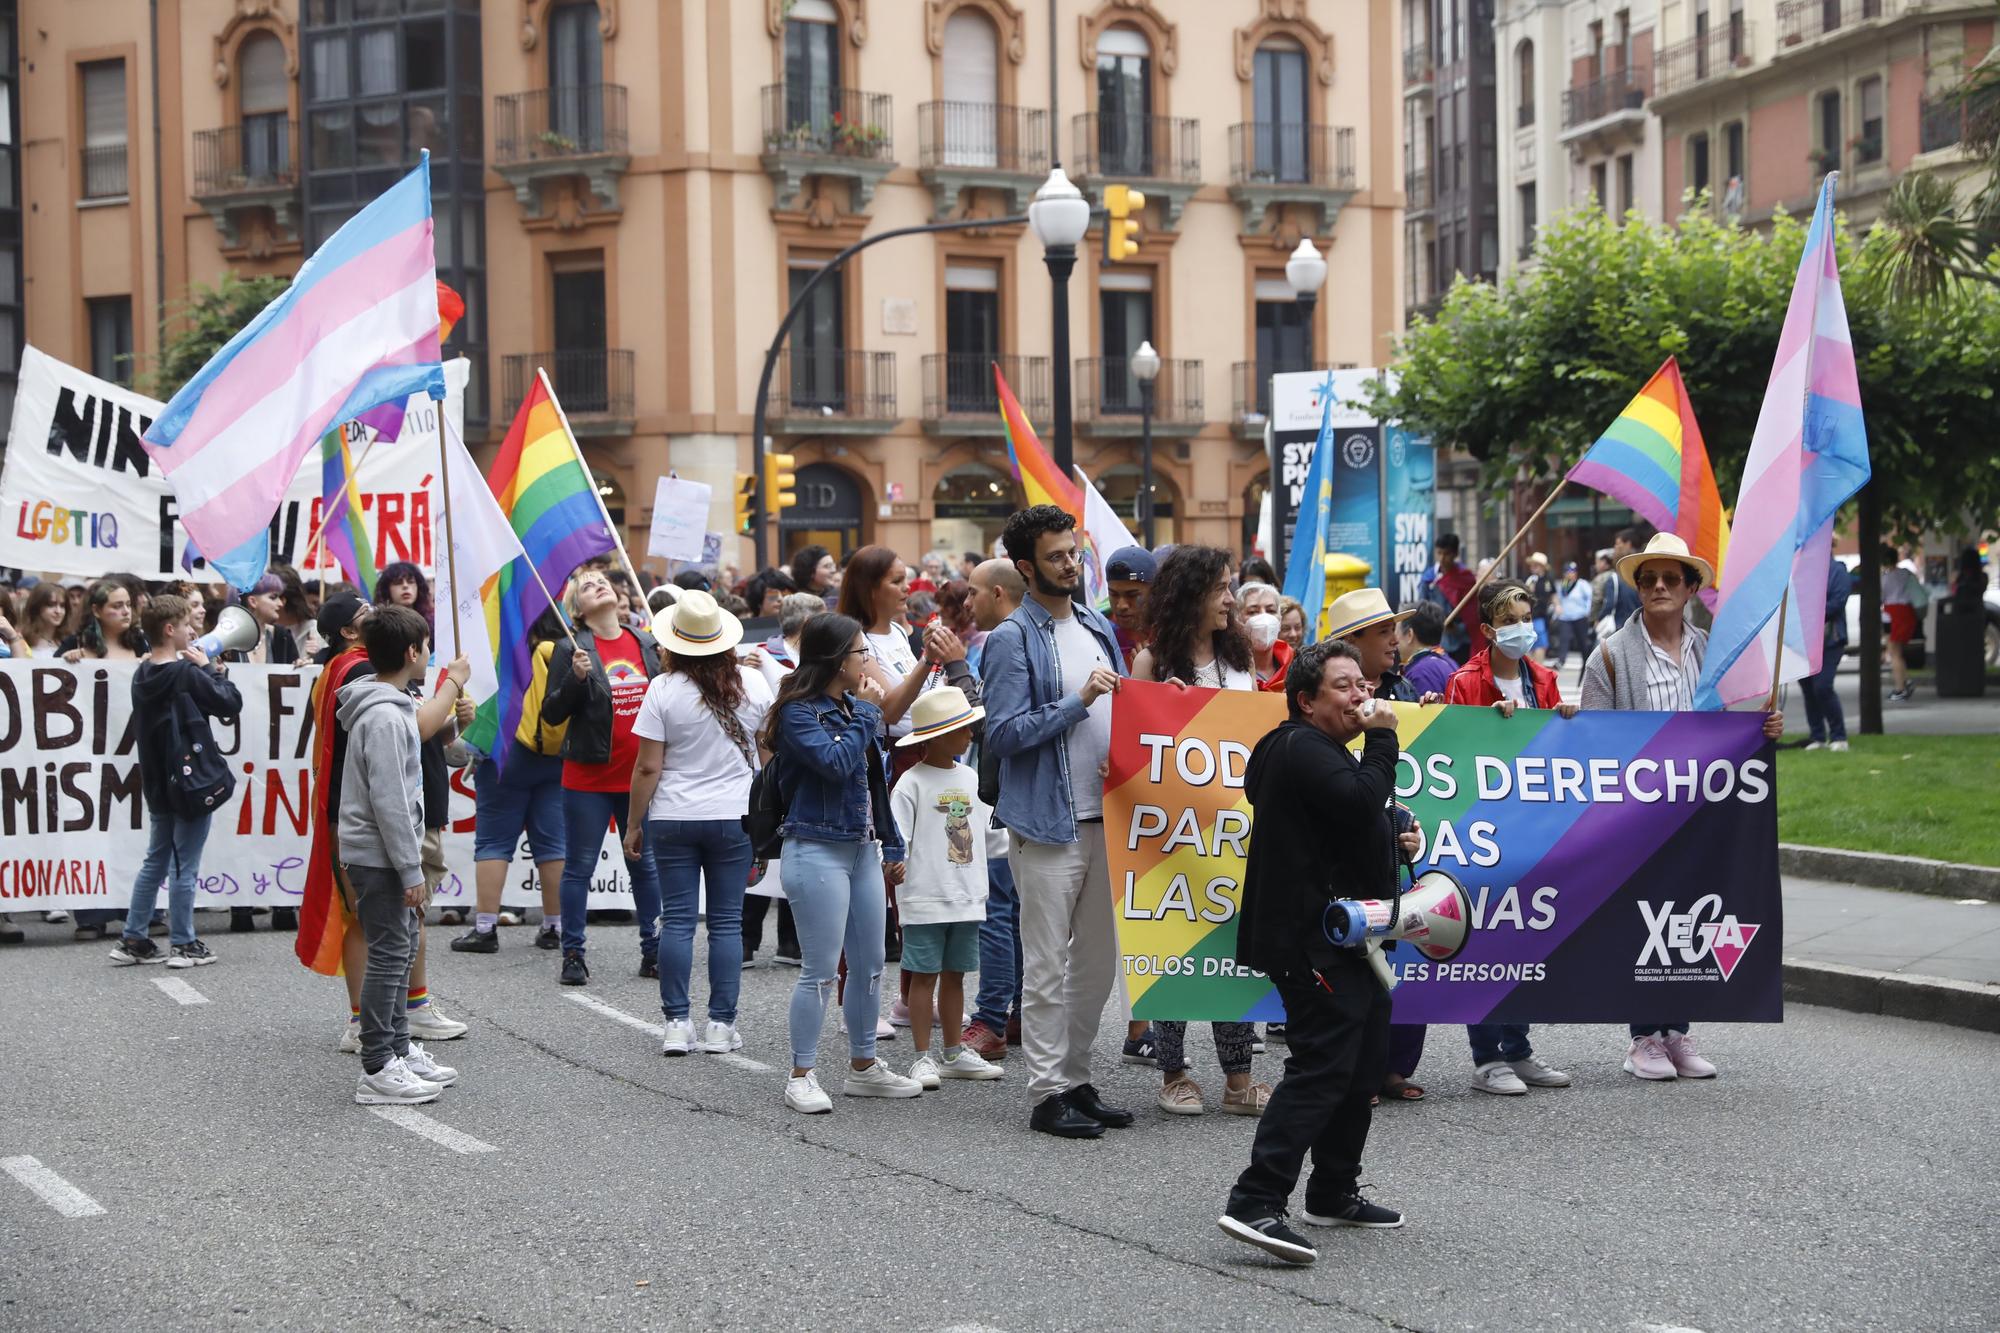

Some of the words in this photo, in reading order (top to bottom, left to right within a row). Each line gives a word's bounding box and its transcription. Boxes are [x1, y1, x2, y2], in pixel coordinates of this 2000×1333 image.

[47, 386, 152, 478] NIN
[17, 501, 118, 548] LGBTIQ
[1395, 514, 1427, 542] SYM
[1395, 544, 1427, 573] PHO
[1139, 733, 1252, 789] TOD
[1396, 750, 1458, 800] OS
[1475, 755, 1769, 804] DERECHOS
[1128, 804, 1251, 859] PAR
[1124, 871, 1238, 924] LAS
[1635, 893, 1746, 966] XEGA
[1123, 955, 1195, 977] TOLOS
[1437, 963, 1547, 983] PERSONES
